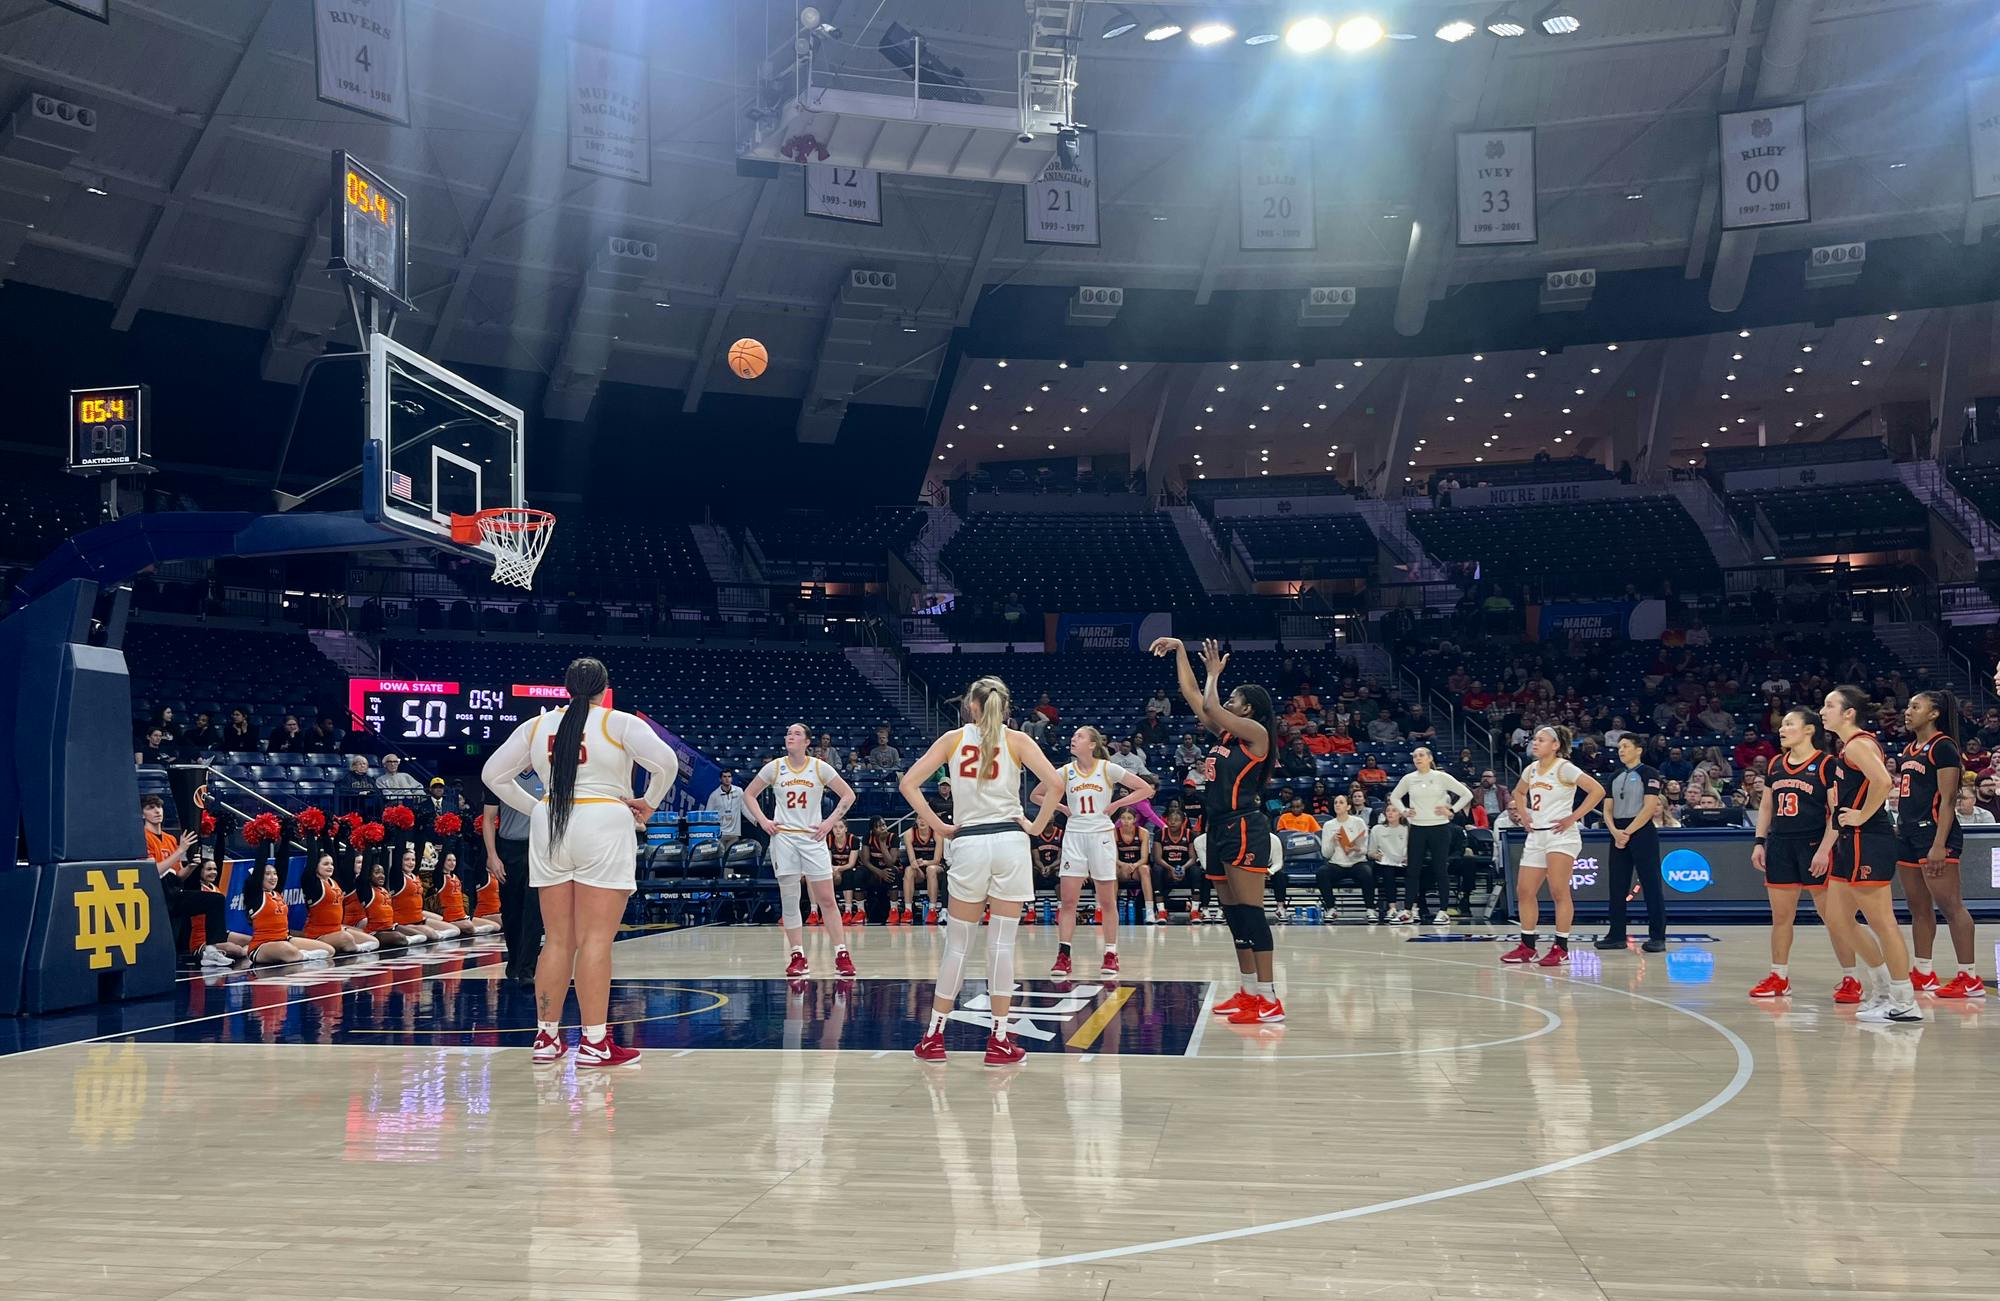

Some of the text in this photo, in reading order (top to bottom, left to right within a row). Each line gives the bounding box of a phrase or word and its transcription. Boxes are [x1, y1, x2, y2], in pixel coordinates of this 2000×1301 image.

[329, 10, 392, 40] RIVERS
[356, 45, 371, 72] 4
[337, 78, 360, 94] 1984
[1741, 145, 1786, 161] RILEY
[832, 168, 858, 187] 12
[1478, 167, 1514, 179] IVEY
[1747, 169, 1779, 193] 00
[347, 171, 388, 225] 05.4
[1047, 188, 1073, 212] 21
[1481, 190, 1510, 213] 33
[1263, 196, 1292, 218] 20
[1739, 204, 1760, 215] 1997
[1770, 202, 1791, 211] 2001
[1040, 221, 1058, 230] 1993
[1067, 223, 1086, 232] 1997
[1501, 222, 1521, 232] 2001
[81, 399, 125, 424] 05.4
[81, 456, 130, 465] DAKTRONICS
[1490, 485, 1581, 503] NOTRE DAME
[1562, 616, 1602, 629] MARCH
[1078, 626, 1114, 637] MARCH
[1083, 637, 1130, 648] MADNESS
[380, 682, 444, 692] IOWA STATE
[529, 687, 571, 697] PRINCE
[469, 689, 504, 710] 05.4
[371, 704, 378, 714] 4
[456, 713, 474, 721] POSS
[402, 699, 447, 738] 50
[483, 726, 490, 739] 3
[781, 778, 814, 788] Cyclones
[1070, 783, 1103, 793] Cyclones
[786, 791, 807, 809] 24
[1080, 796, 1095, 814] 11
[1532, 794, 1541, 811] 2
[1776, 792, 1799, 817] 13
[1668, 870, 1709, 882] NCAA
